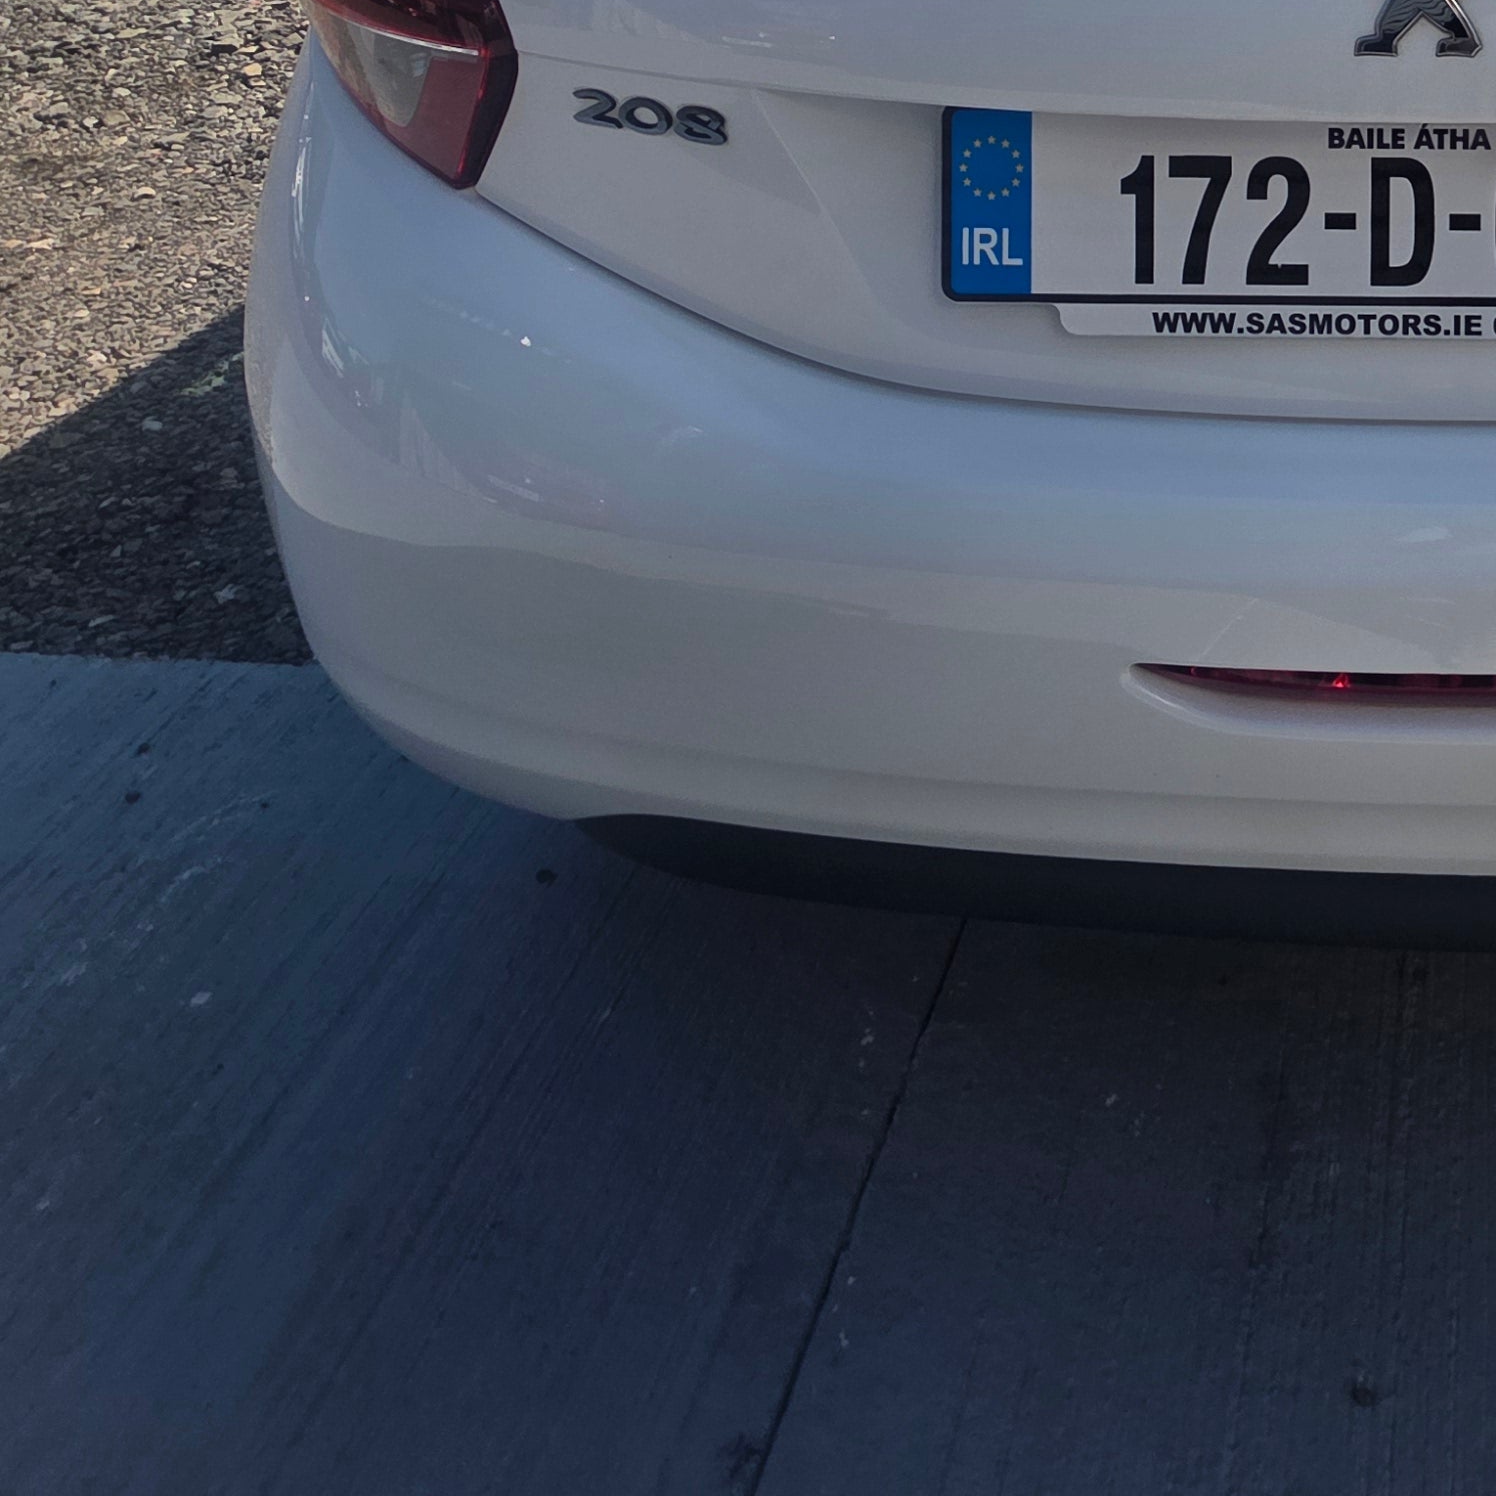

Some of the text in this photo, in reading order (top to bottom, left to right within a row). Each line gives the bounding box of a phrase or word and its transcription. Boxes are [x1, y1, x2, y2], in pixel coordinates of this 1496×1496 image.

[572, 88, 727, 145] 208
[1328, 128, 1405, 149] BAILE
[1413, 123, 1491, 150] ÁTHA
[961, 228, 1024, 266] IRL
[1153, 312, 1481, 336] WWW.SASMOTORS.IE
